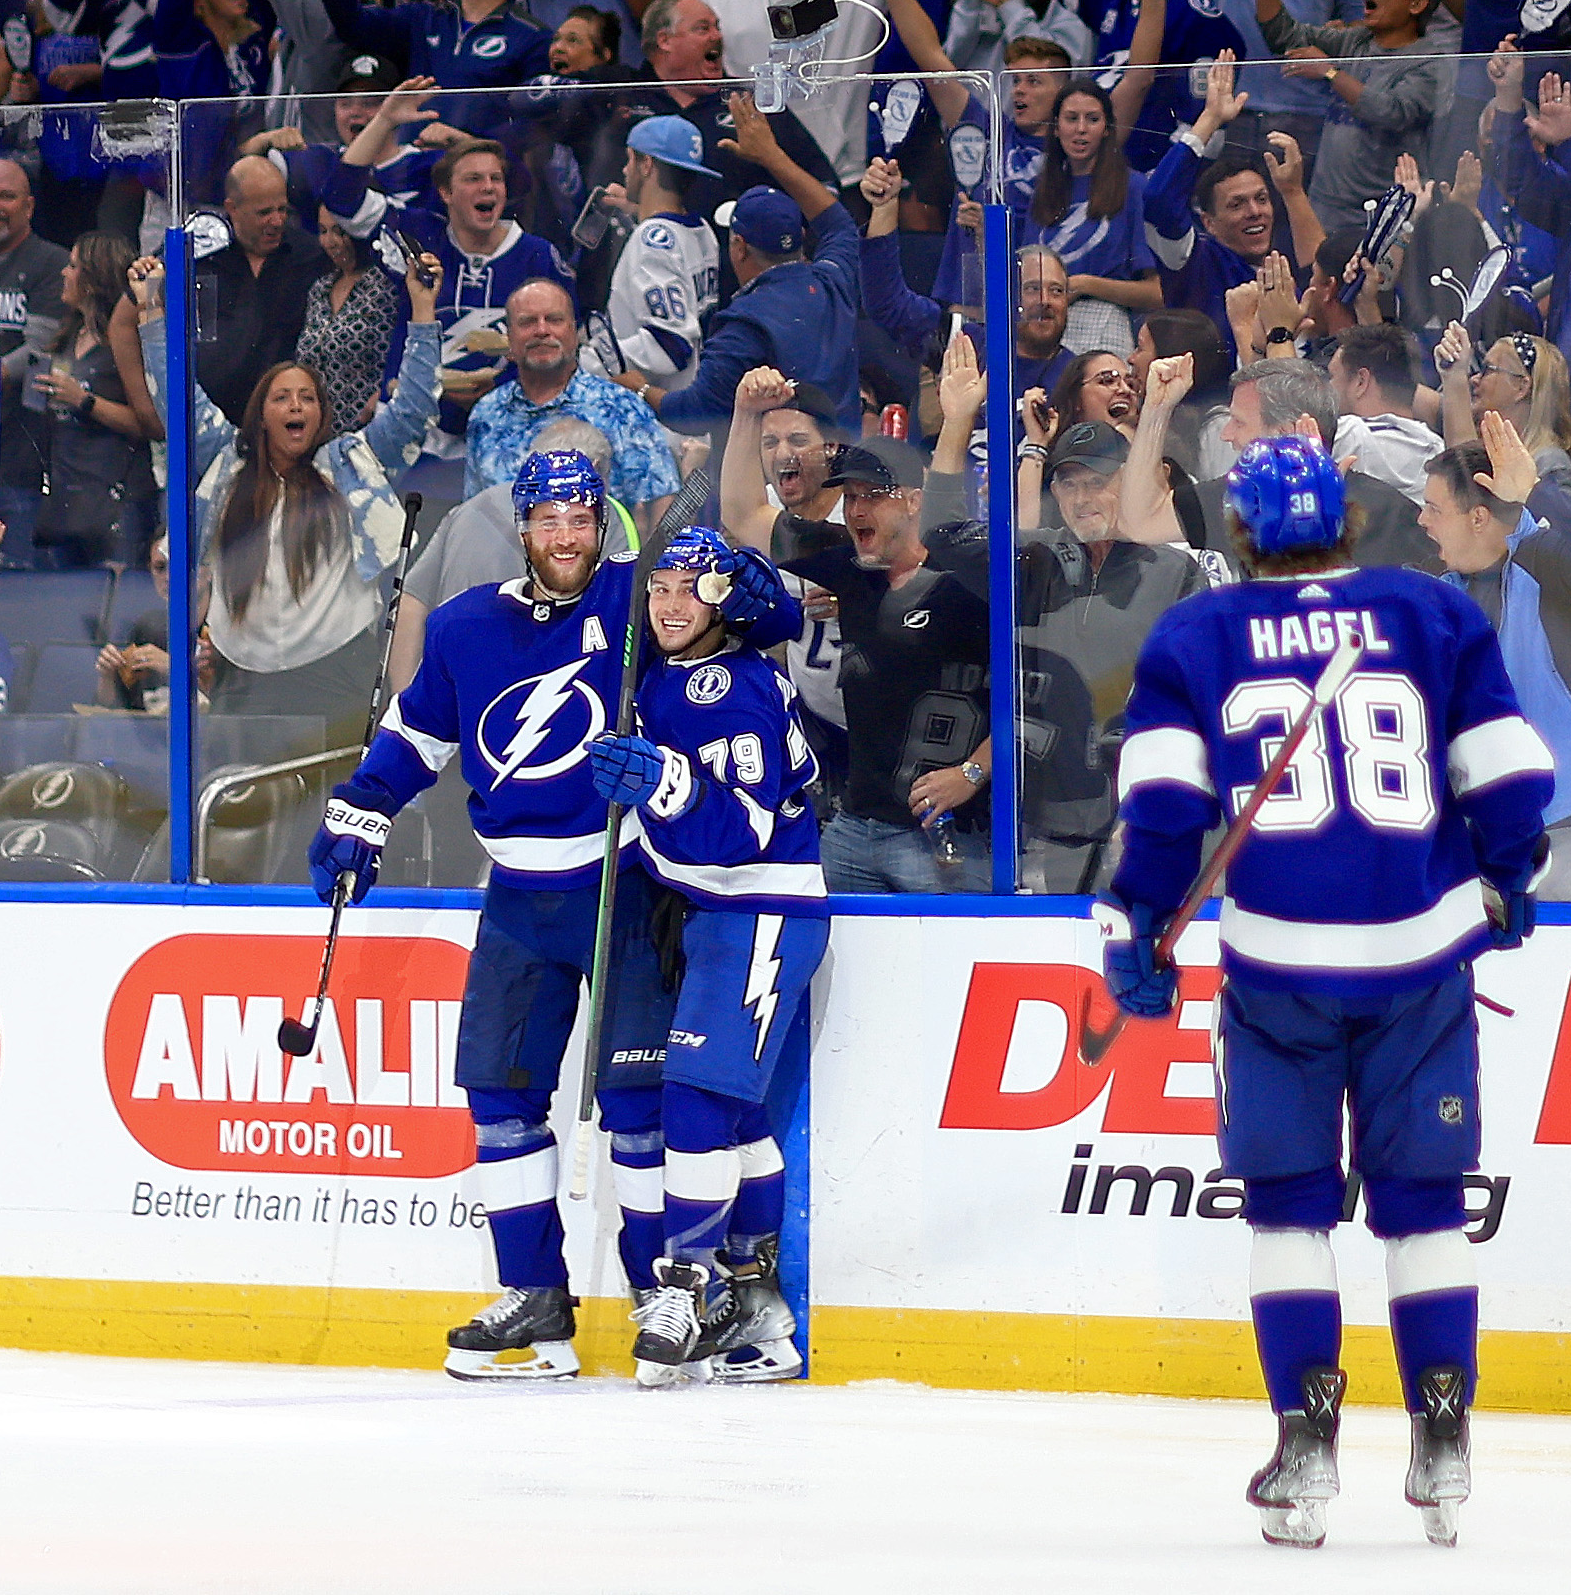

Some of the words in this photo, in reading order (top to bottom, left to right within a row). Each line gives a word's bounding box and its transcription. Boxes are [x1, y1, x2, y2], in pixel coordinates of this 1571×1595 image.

[644, 284, 686, 321] 86
[1289, 492, 1316, 514] 38
[581, 615, 609, 654] A
[1249, 610, 1390, 661] HAGEL
[697, 732, 765, 785] 79
[1221, 671, 1440, 833] 38
[610, 1048, 668, 1065] BAUE
[938, 961, 1227, 1136] DE
[219, 1120, 338, 1158] MOTOR
[346, 1123, 403, 1159] OIL
[132, 1181, 225, 1218] Better
[234, 1187, 301, 1222] than
[312, 1187, 330, 1223] it
[340, 1189, 397, 1225] has
[409, 1192, 436, 1227] to
[449, 1192, 487, 1230] be
